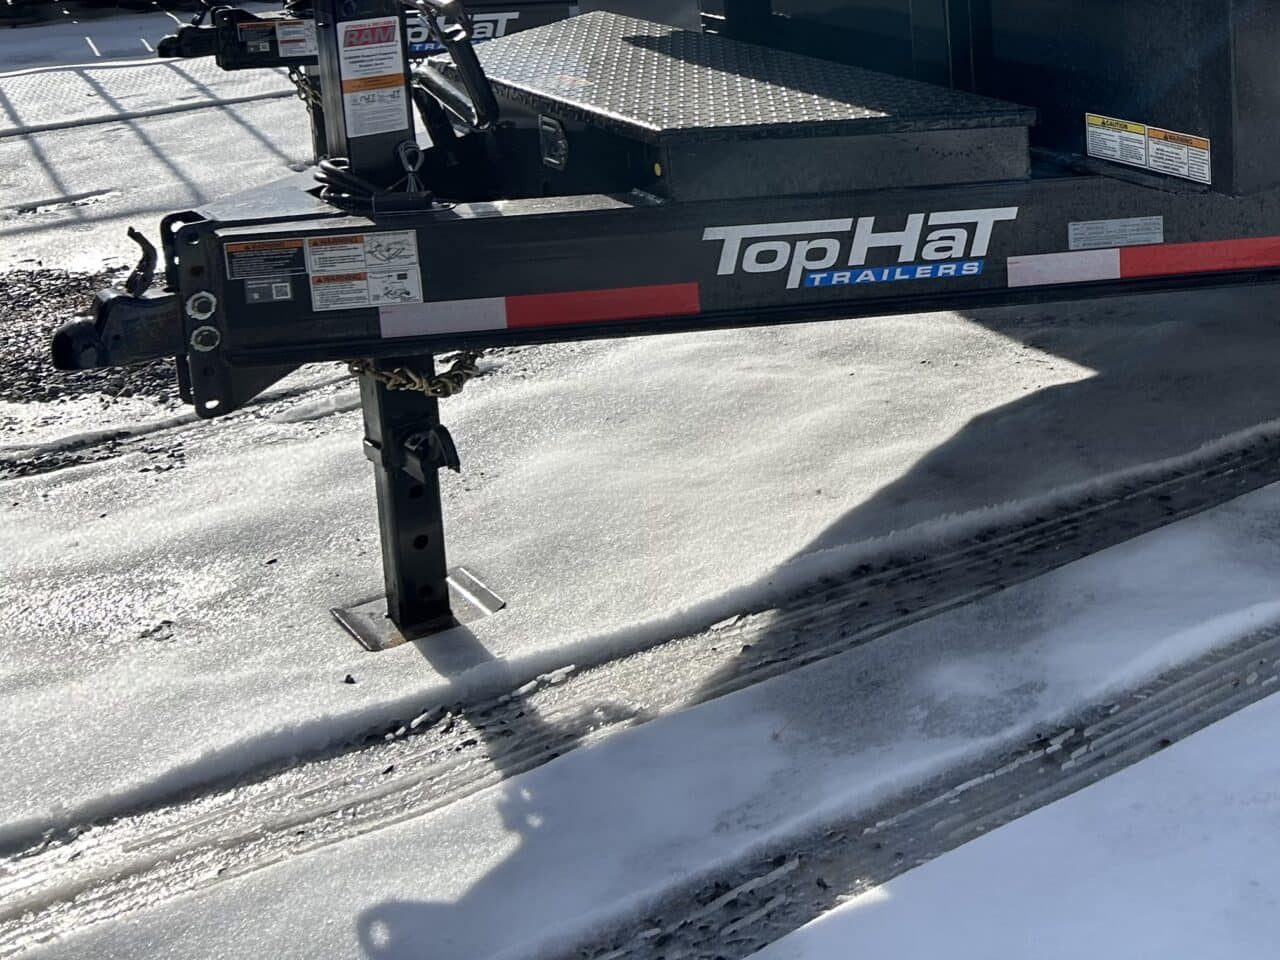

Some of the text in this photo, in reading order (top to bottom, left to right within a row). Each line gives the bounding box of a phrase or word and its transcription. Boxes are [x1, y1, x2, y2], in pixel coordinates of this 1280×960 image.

[345, 26, 397, 47] RAM
[1105, 119, 1128, 130] CAUTION
[809, 262, 980, 286] TRAILERS
